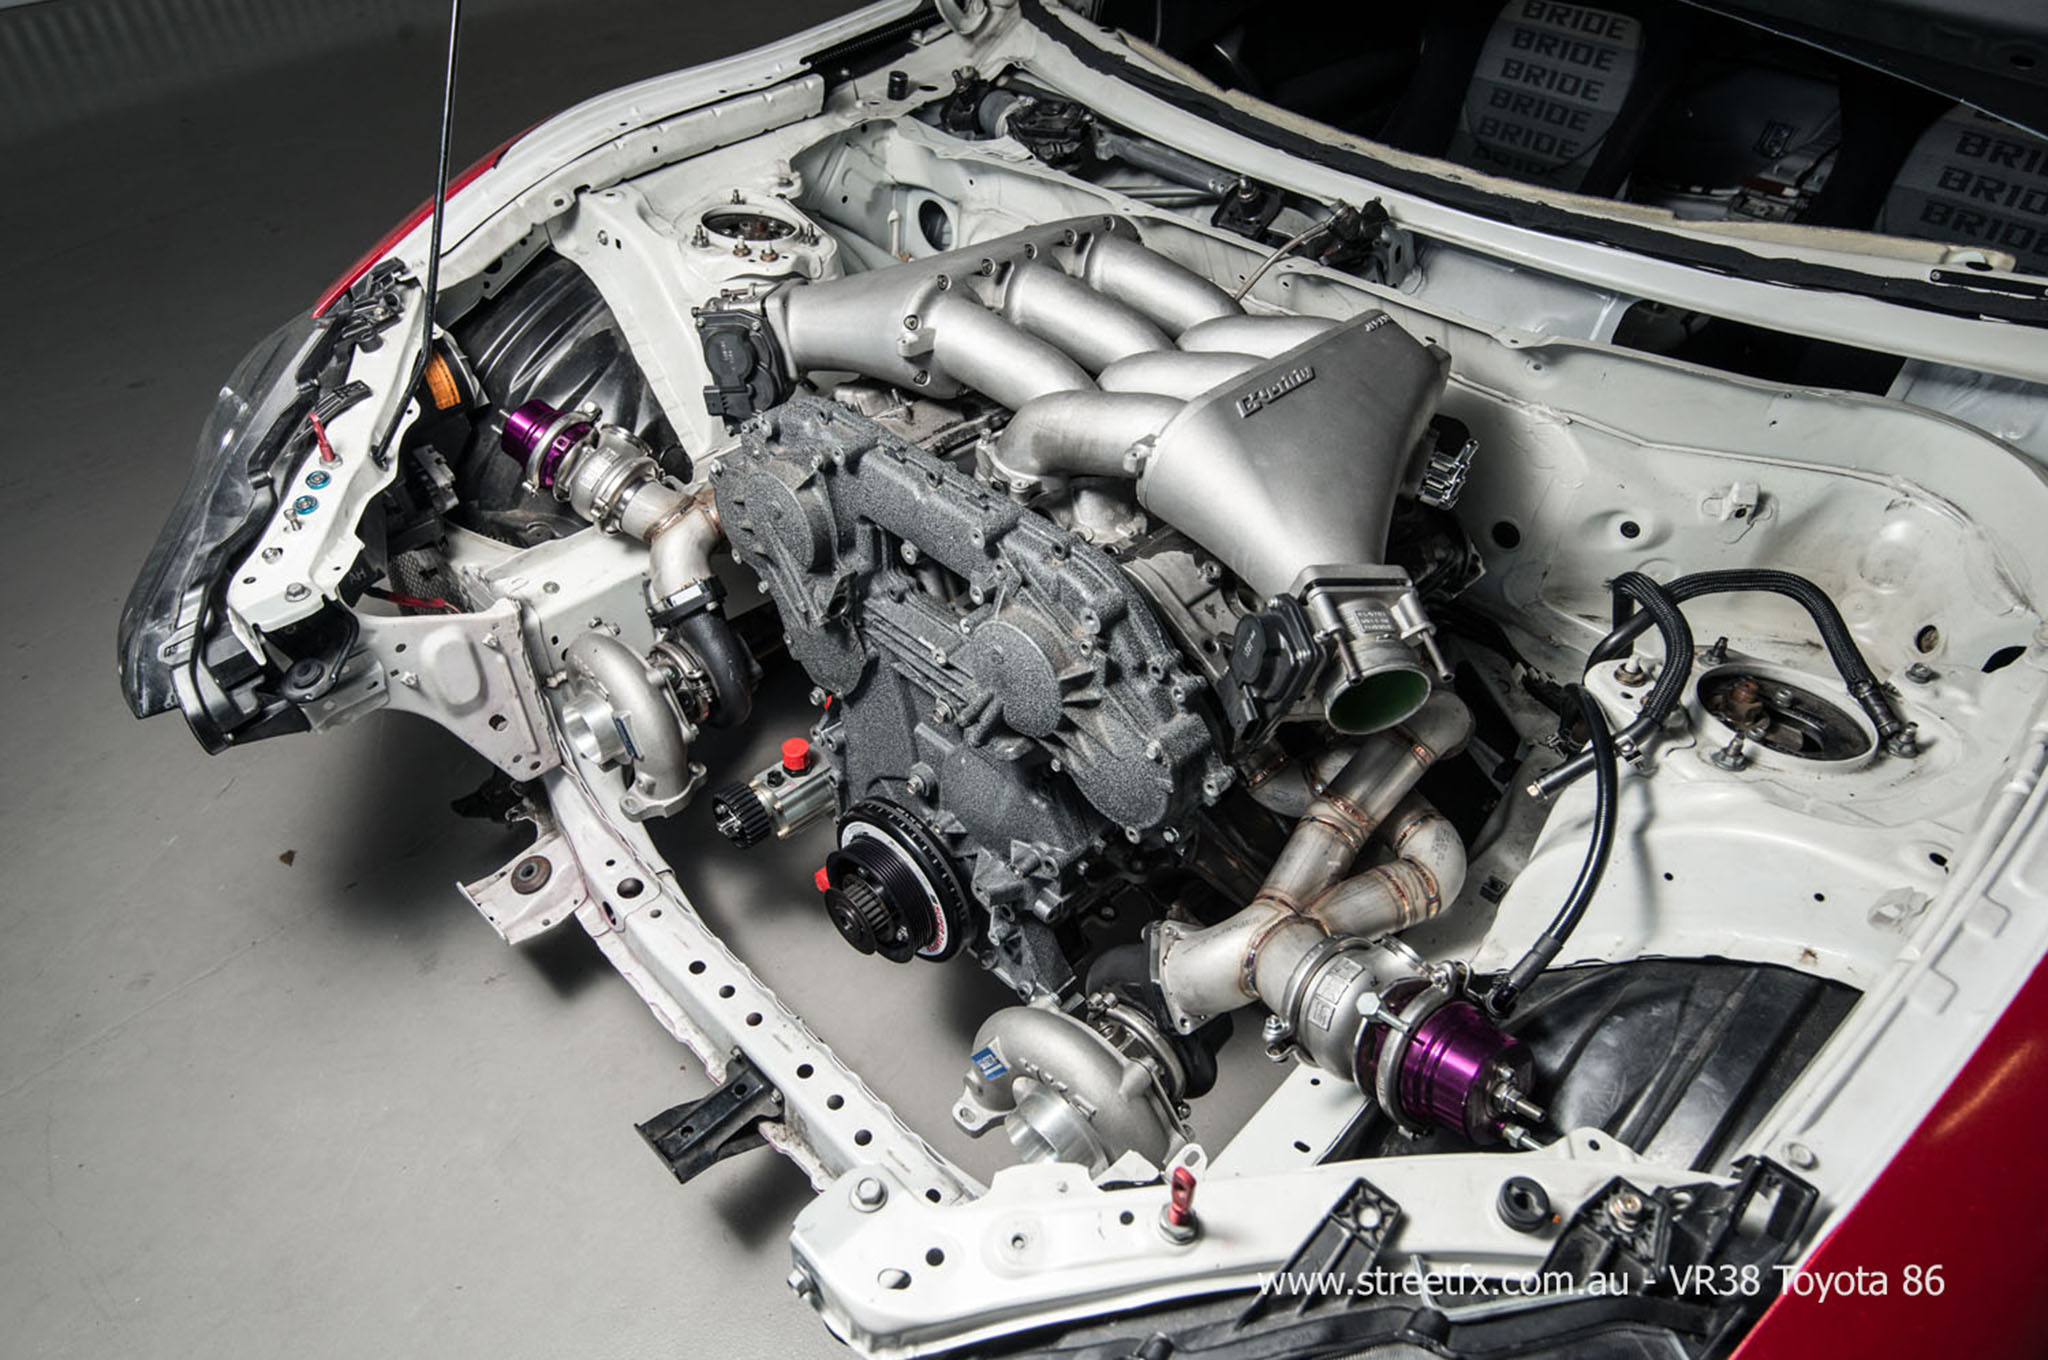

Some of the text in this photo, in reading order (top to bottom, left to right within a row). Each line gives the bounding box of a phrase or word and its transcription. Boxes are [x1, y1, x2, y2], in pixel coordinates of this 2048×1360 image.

[1521, 0, 1631, 41] BRIDE
[1511, 27, 1617, 71] BRIDE
[1500, 58, 1605, 102] BRIDE
[1490, 89, 1591, 133] BRIDE
[1480, 116, 1581, 161] BRIDE
